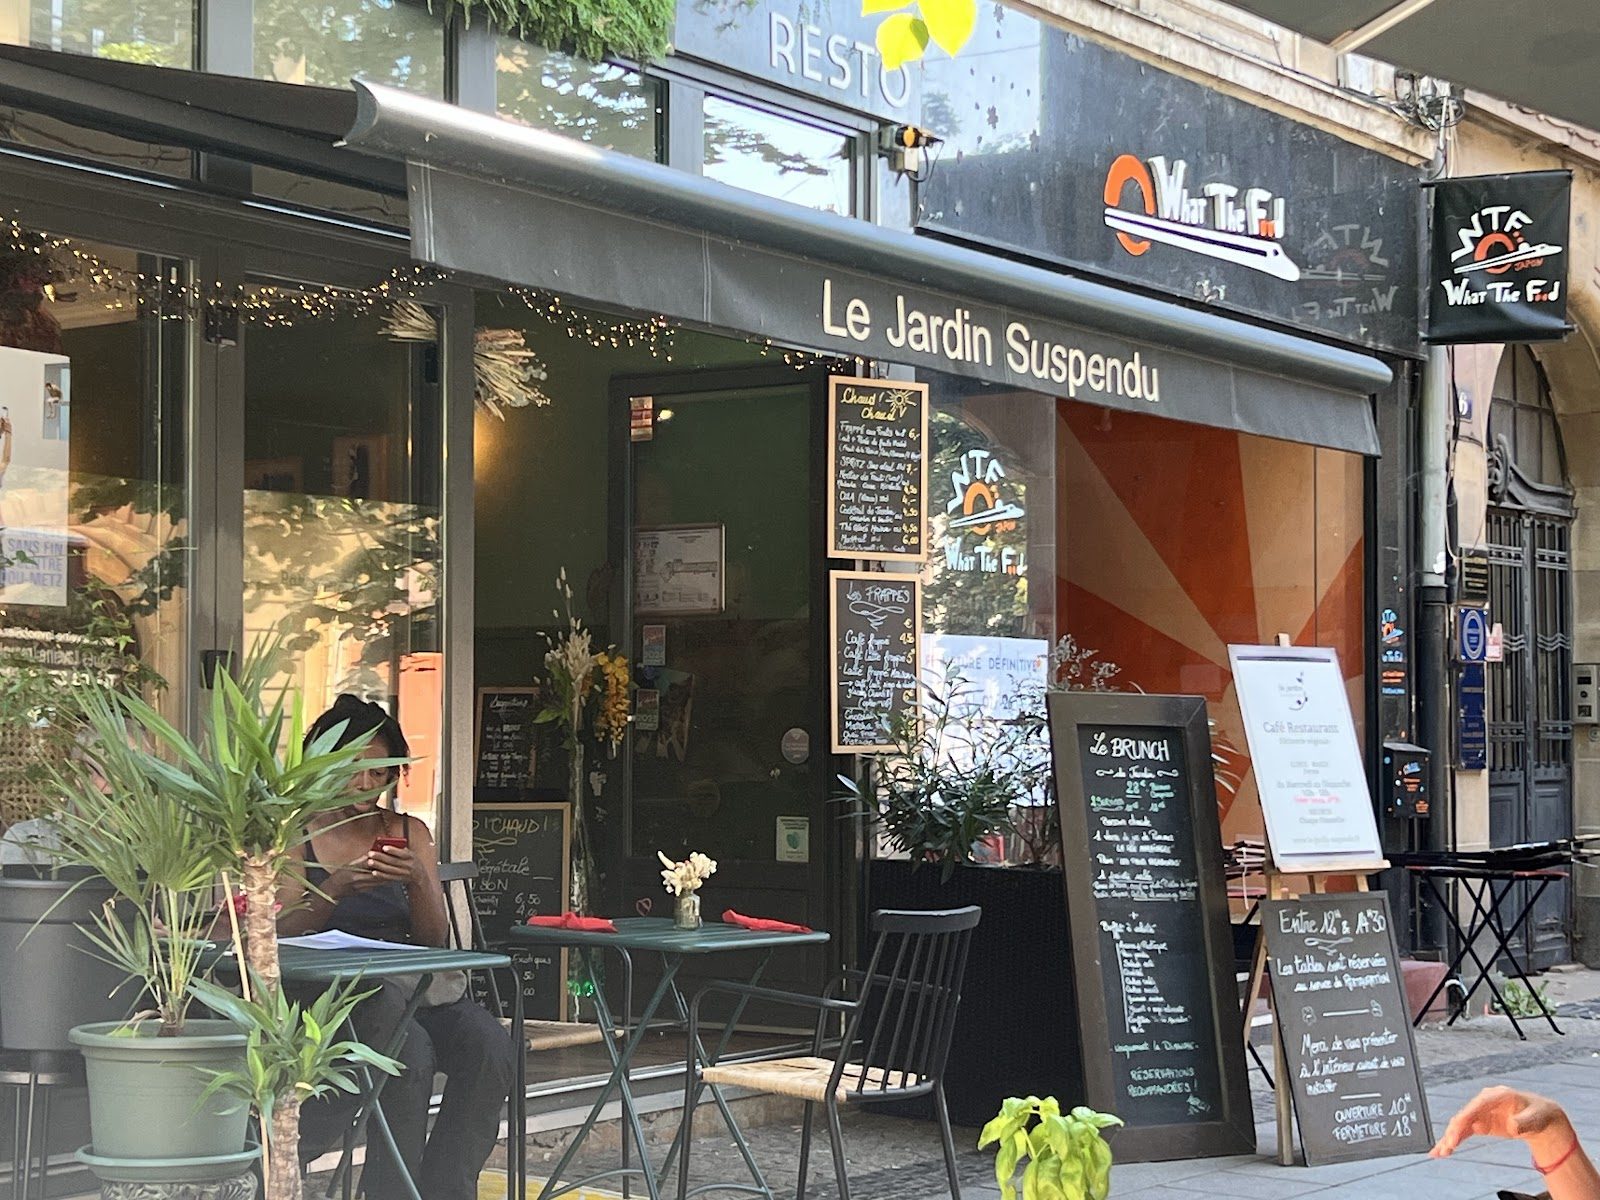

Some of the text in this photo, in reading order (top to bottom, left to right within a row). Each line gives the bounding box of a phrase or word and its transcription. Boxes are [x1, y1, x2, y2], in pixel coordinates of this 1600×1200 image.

[769, 10, 912, 109] RESTO
[1441, 278, 1487, 306] What
[1486, 281, 1521, 303] The
[823, 279, 1160, 402] Le Jardin Suspendu
[44, 542, 64, 557] FIN
[1262, 721, 1340, 735] Café Restaurant
[1089, 732, 1170, 762] Le BRUNCH
[1279, 909, 1318, 934] Entre
[1294, 954, 1326, 974] tables
[1301, 1032, 1329, 1057] Merci
[1331, 1034, 1343, 1051] de
[1334, 1102, 1385, 1123] OUVERTURE
[1332, 1121, 1388, 1141] FERMETURE
